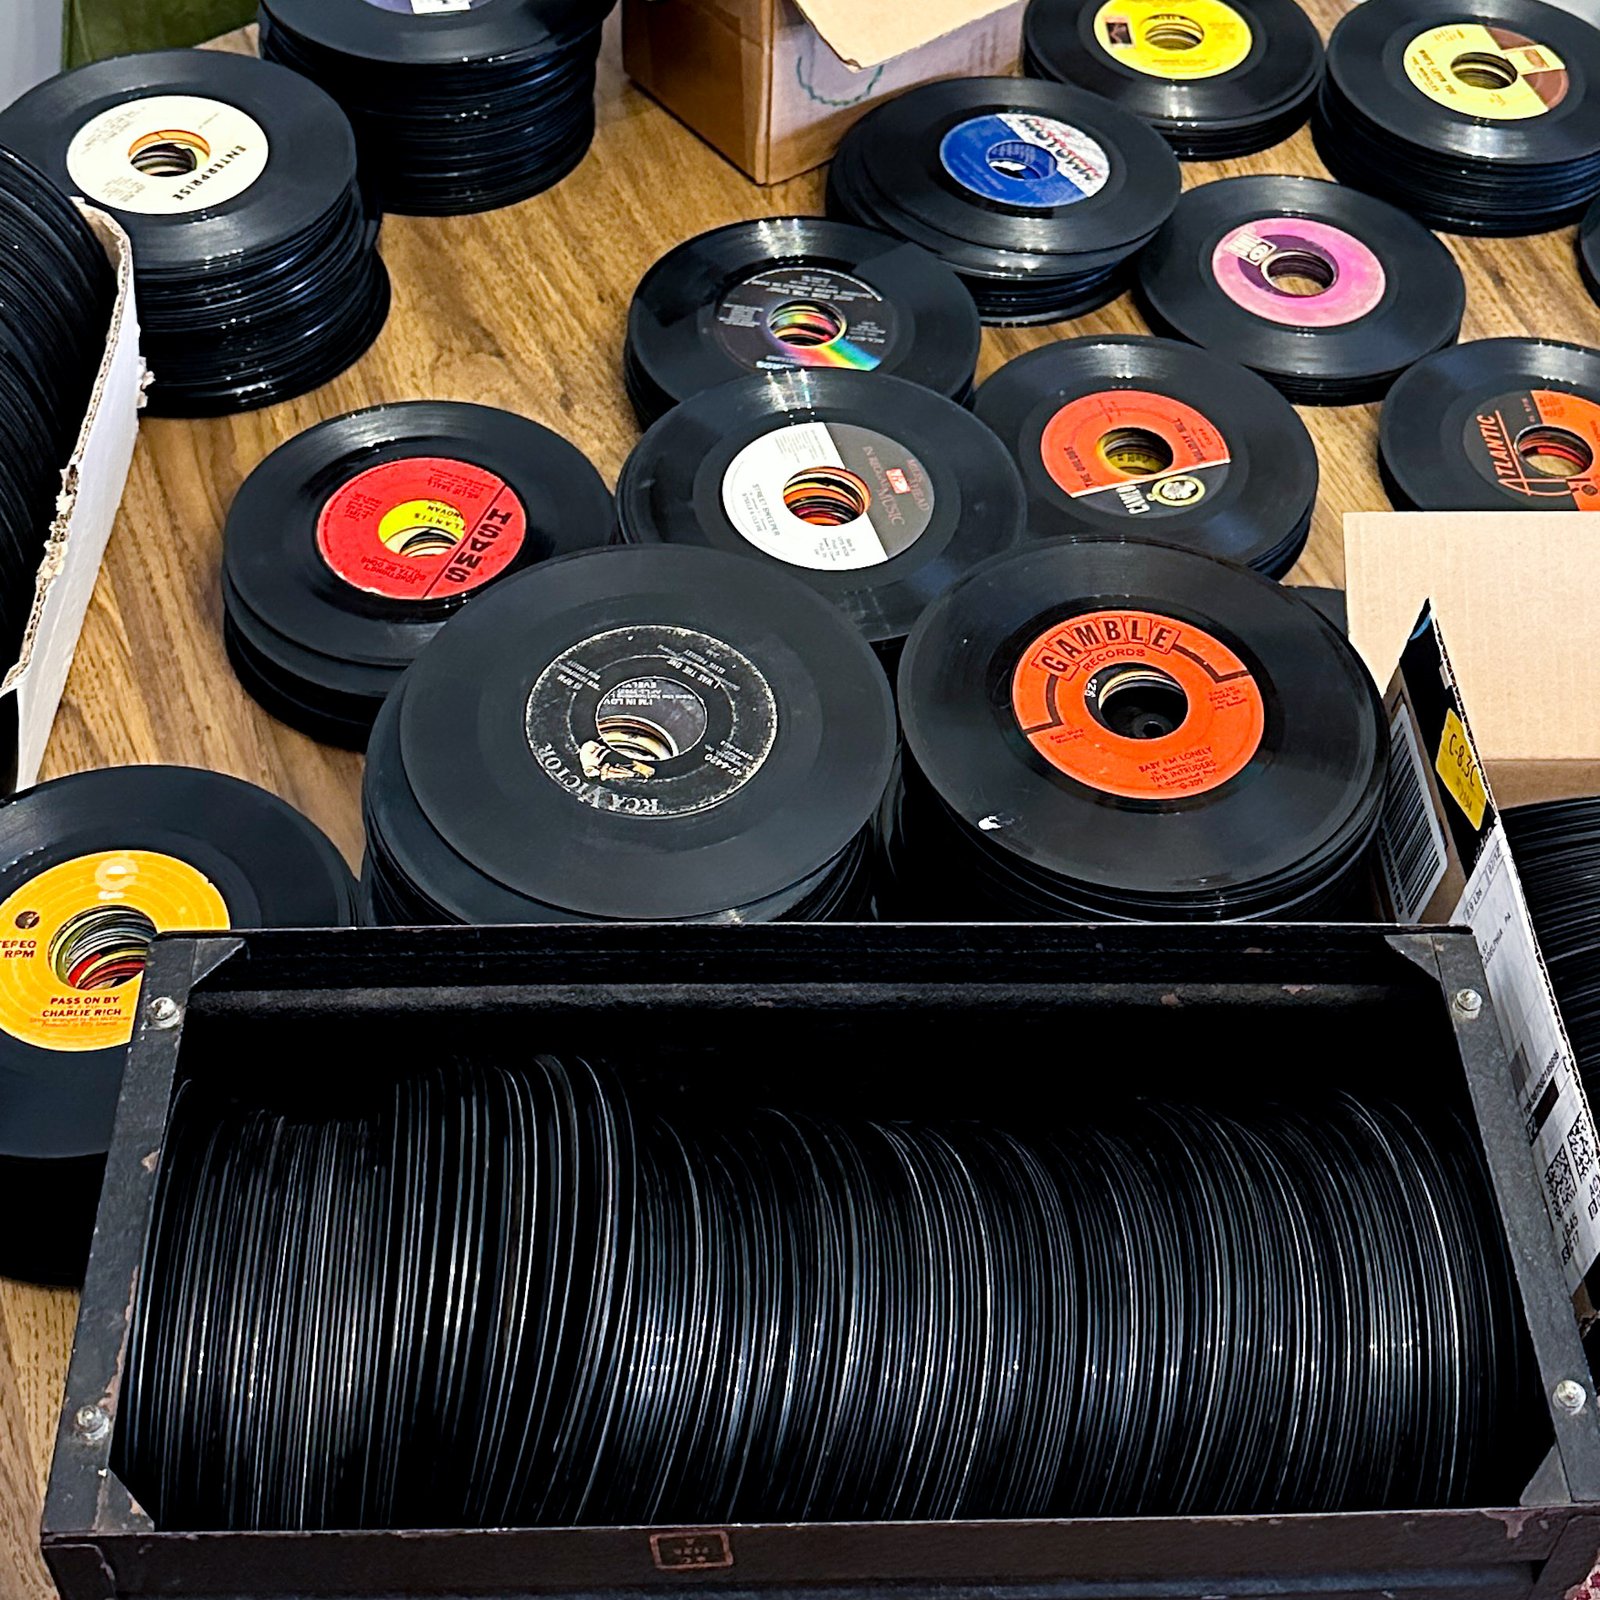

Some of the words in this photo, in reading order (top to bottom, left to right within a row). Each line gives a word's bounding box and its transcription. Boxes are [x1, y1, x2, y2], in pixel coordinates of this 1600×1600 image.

[172, 145, 247, 201] ENTERPRISE
[879, 488, 905, 526] MUSIC
[444, 507, 513, 583] SMASH
[1041, 619, 1173, 673] GAMBLE
[666, 658, 683, 669] ONE
[1083, 648, 1146, 672] RECORDS
[682, 665, 698, 678] THE
[556, 673, 575, 686] RPM
[697, 674, 716, 687] WAS
[603, 698, 624, 706] LOV
[626, 698, 637, 706] IN
[638, 698, 653, 706] I'M
[1138, 759, 1162, 774] BABY
[1163, 755, 1179, 767] I'M
[1181, 746, 1213, 762] LONELY
[538, 742, 601, 809] VICTOR
[1151, 774, 1169, 784] THE
[1171, 760, 1217, 780] INTRUDERS
[608, 793, 659, 811] RCA
[4, 950, 35, 959] RPM
[50, 996, 82, 1005] PASS
[84, 996, 102, 1004] ON
[103, 995, 120, 1004] BY
[42, 1009, 92, 1018] CHARLIE
[94, 1008, 122, 1017] RICH
